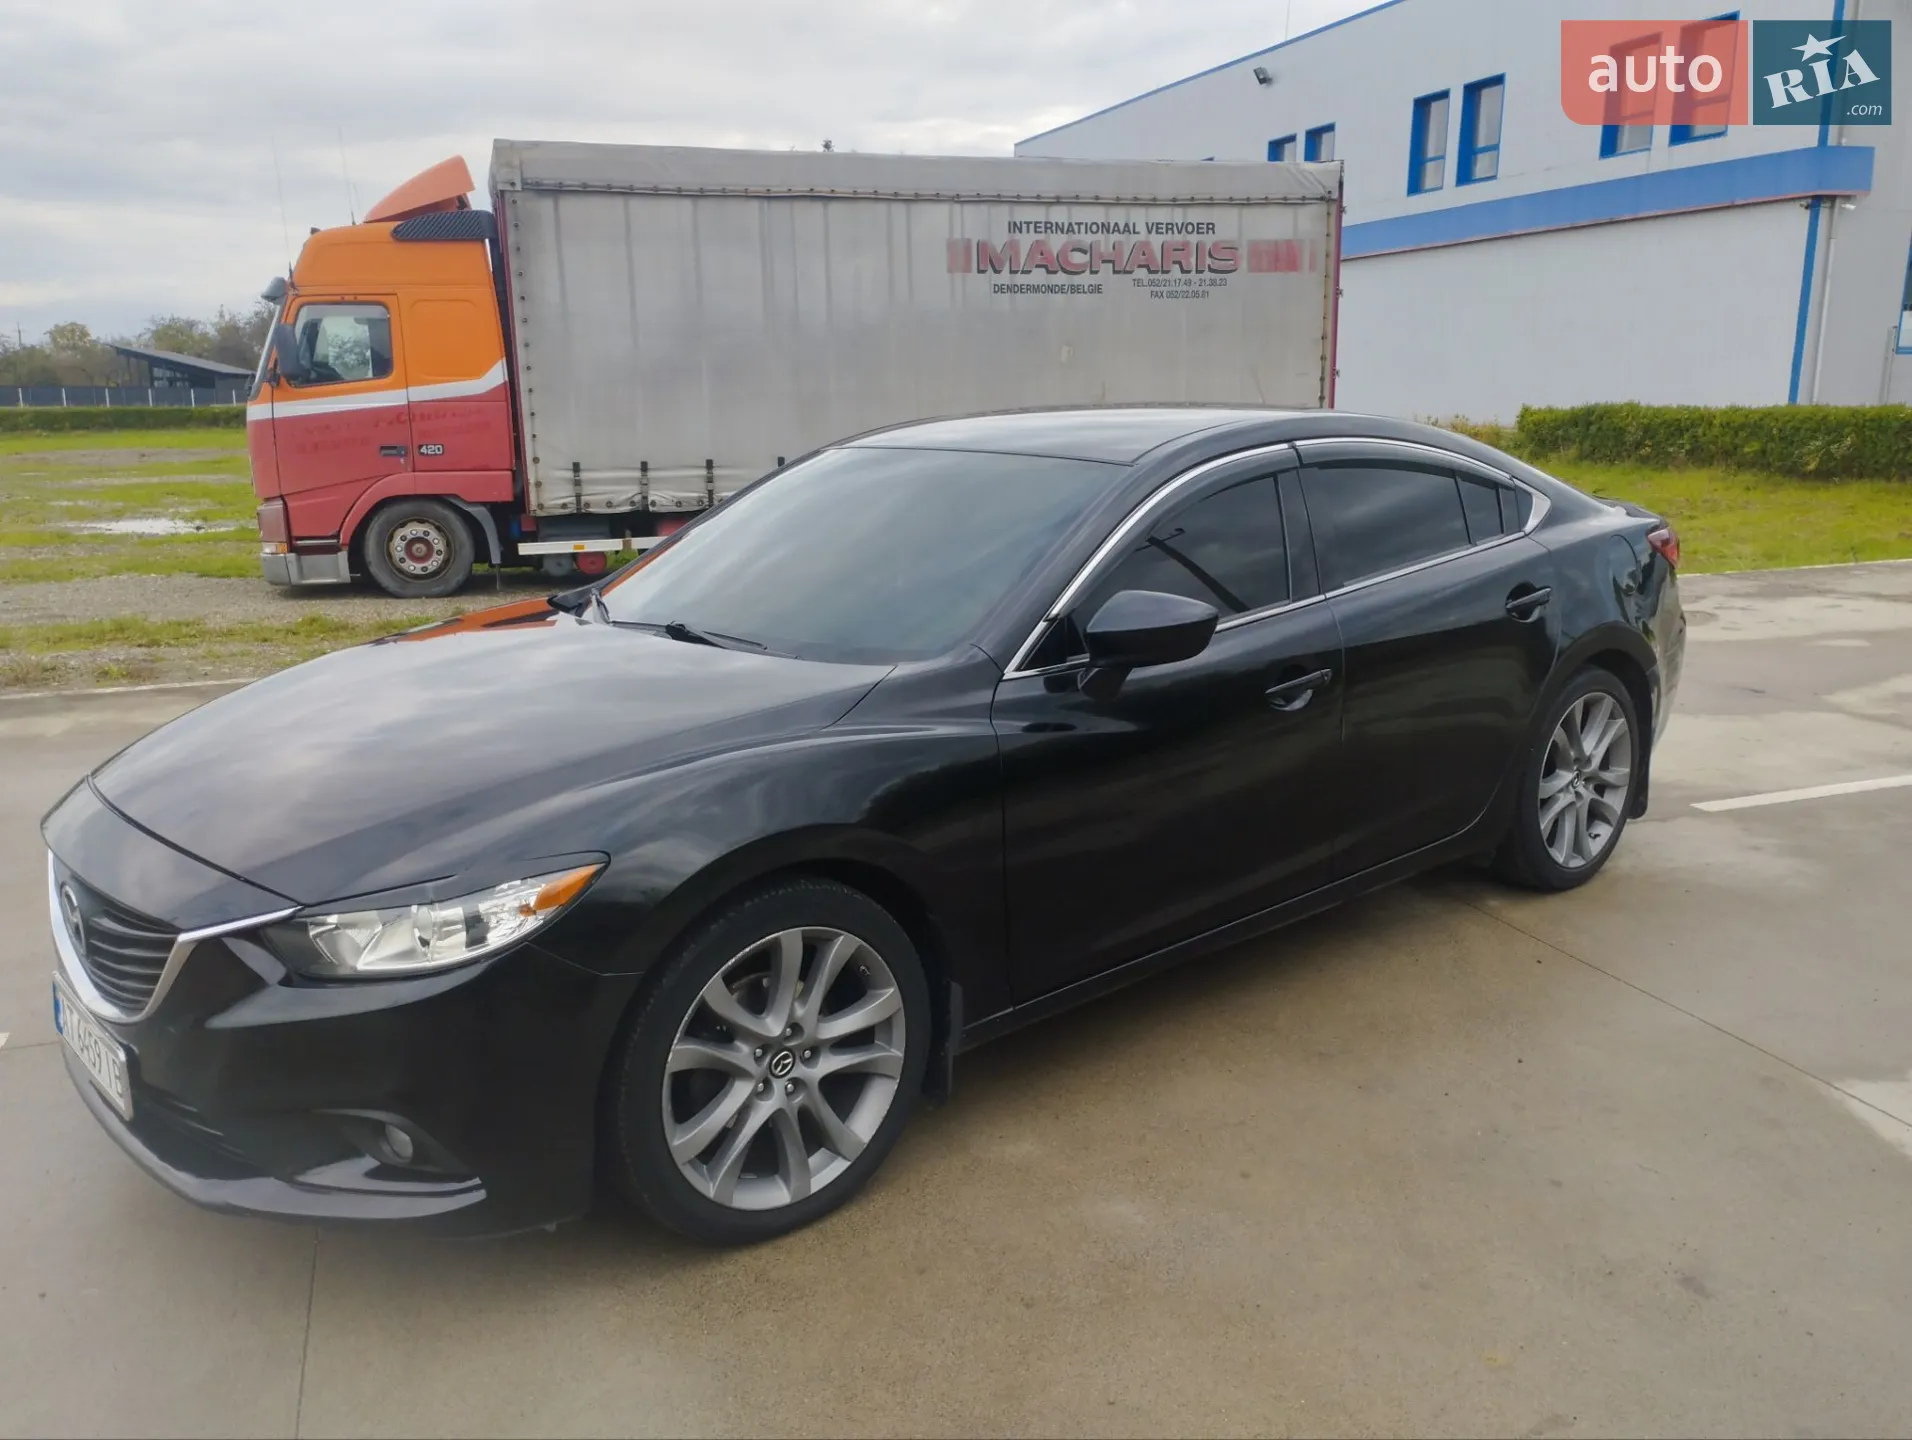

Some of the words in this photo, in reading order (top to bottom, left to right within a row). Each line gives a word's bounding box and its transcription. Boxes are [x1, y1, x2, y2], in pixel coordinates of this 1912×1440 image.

[1007, 221, 1140, 235] INTERNATIONAAL
[1145, 221, 1216, 236] VERVOER
[976, 238, 1243, 275] MACHARIS
[993, 283, 1103, 295] DENDERMONDE/BELGIE
[1149, 289, 1164, 300] FAX
[420, 444, 443, 455] 420
